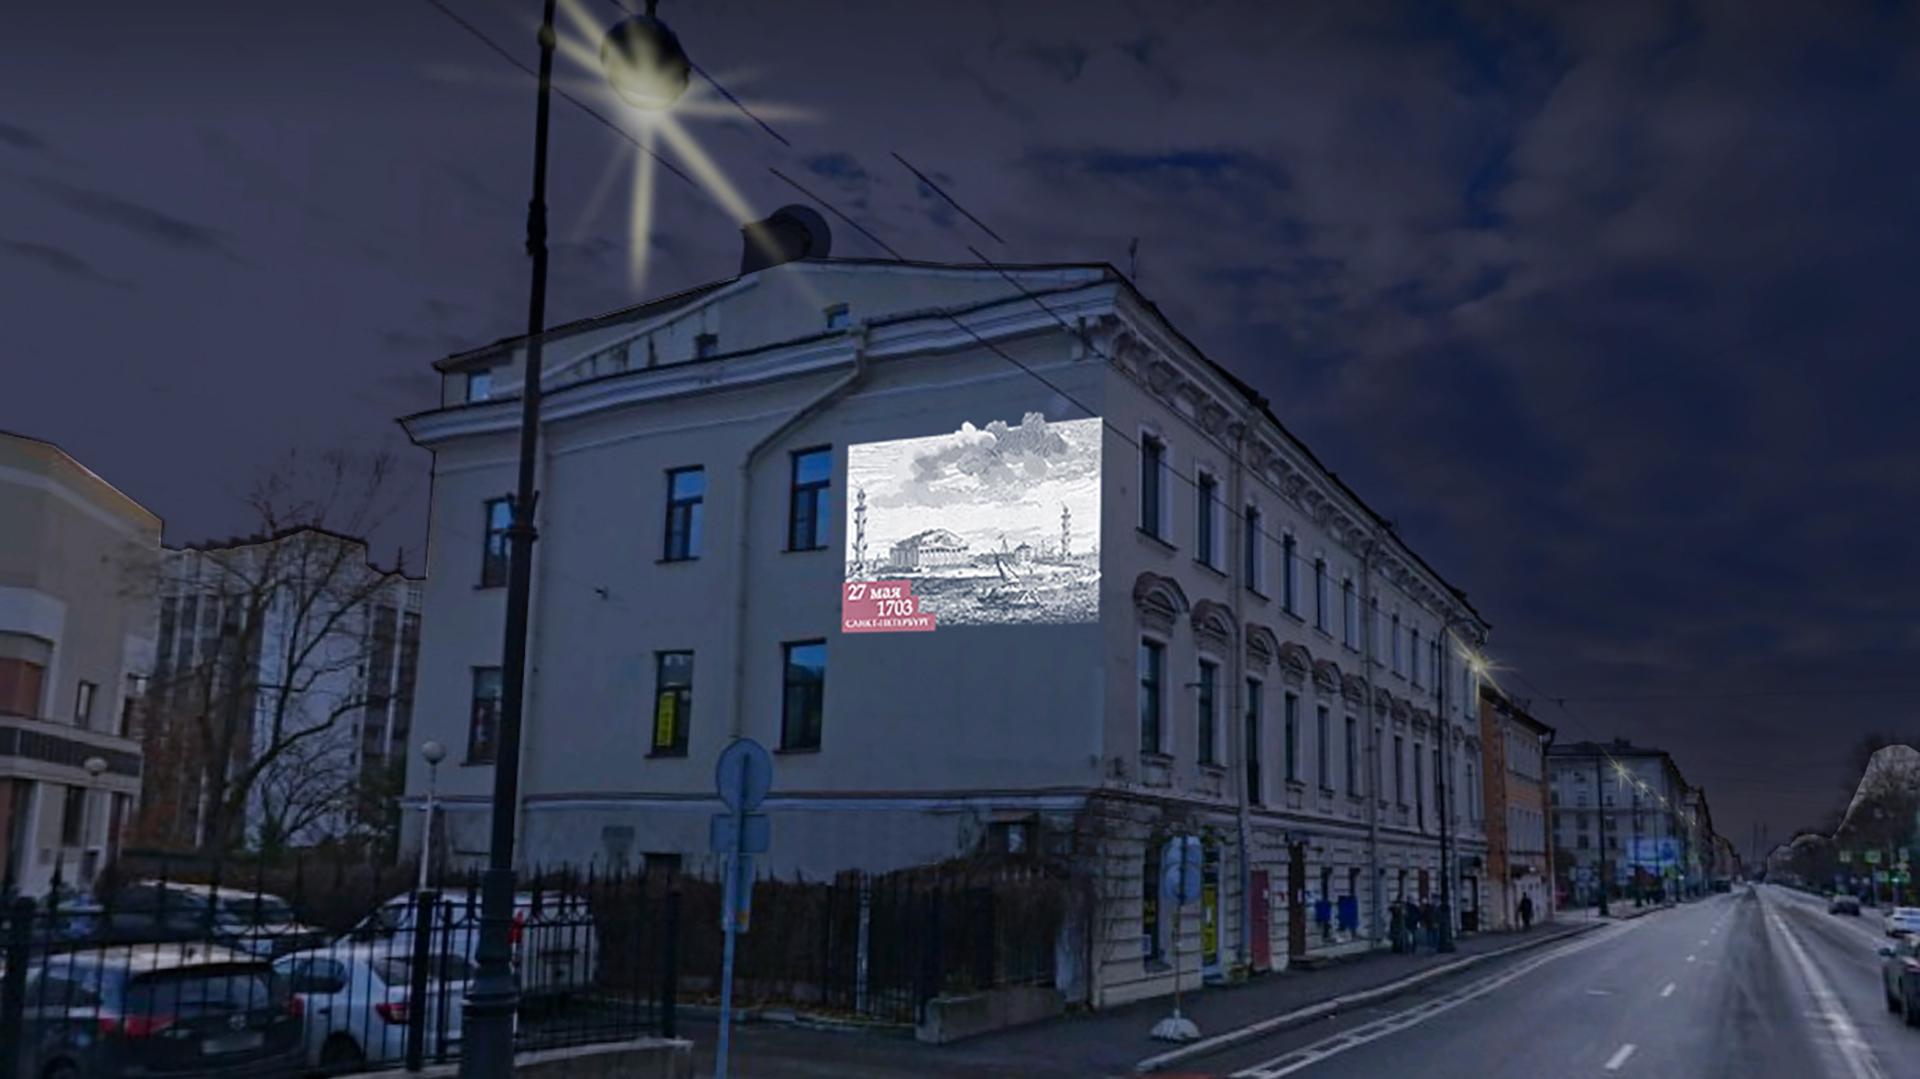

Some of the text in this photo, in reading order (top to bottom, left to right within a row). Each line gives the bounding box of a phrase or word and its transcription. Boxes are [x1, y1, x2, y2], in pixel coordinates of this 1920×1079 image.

[847, 584, 901, 600] 27 мая
[877, 599, 913, 616] 1703
[844, 617, 928, 628] САНКТ-ПЕТЕРБУРГ
